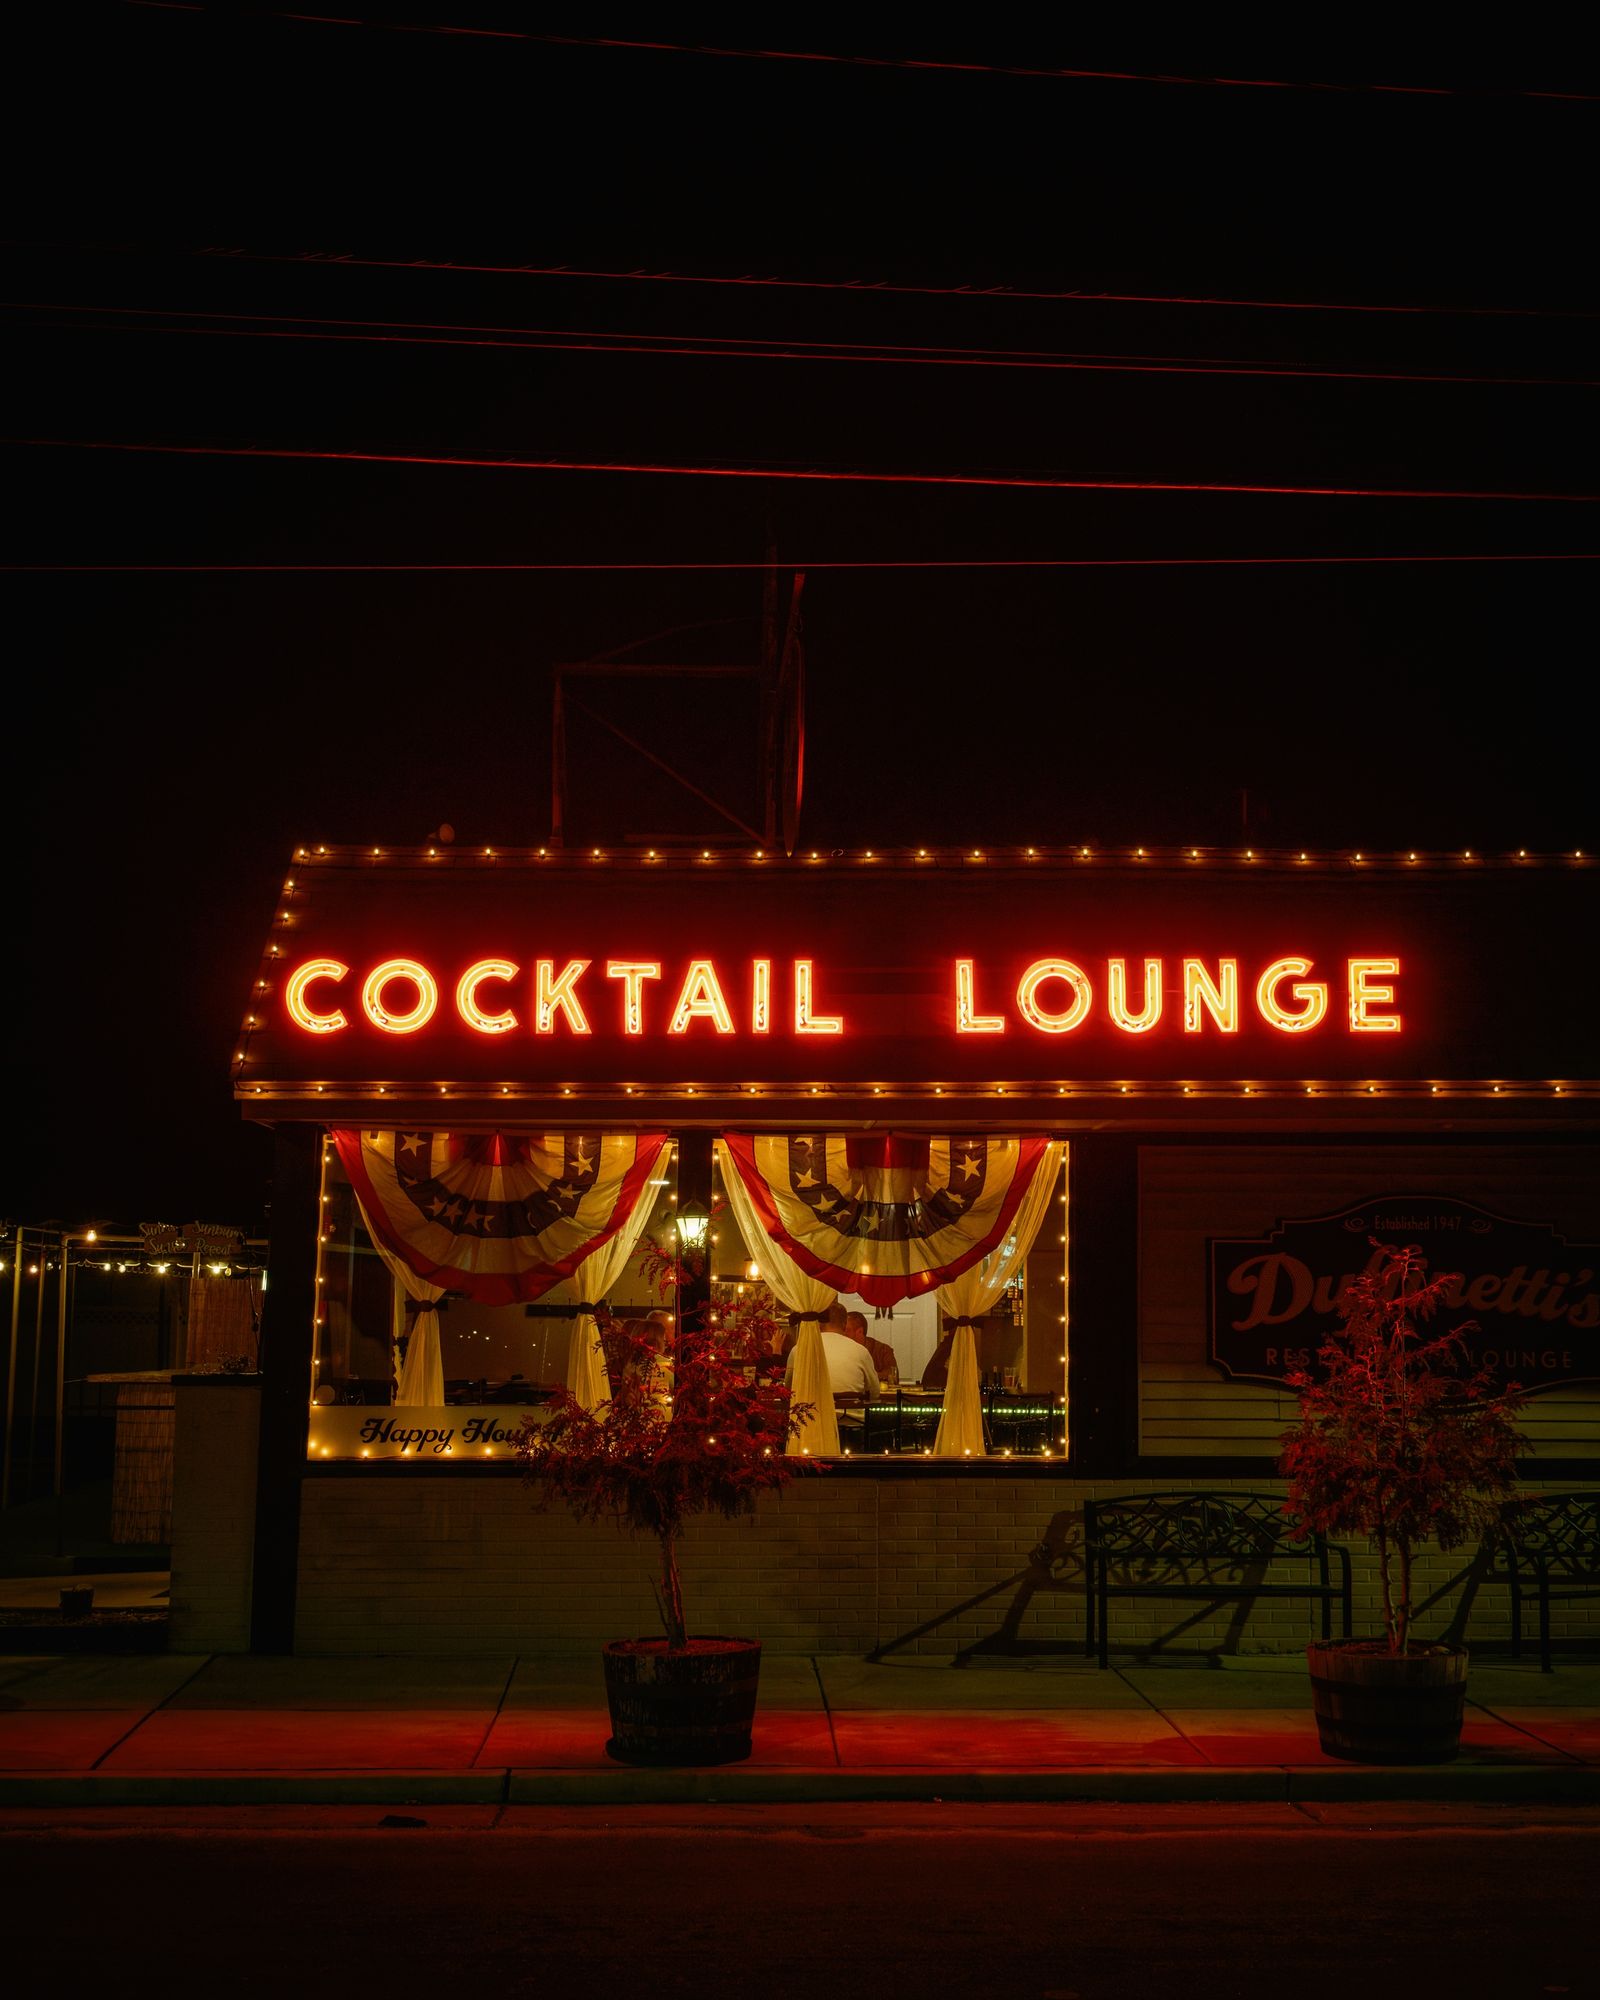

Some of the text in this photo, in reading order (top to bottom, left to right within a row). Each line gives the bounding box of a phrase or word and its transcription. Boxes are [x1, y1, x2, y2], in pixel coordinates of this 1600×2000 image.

[285, 957, 1401, 1035] COCKTAIL LOUNGE
[1374, 1214, 1464, 1232] Established 1947
[1470, 1348, 1574, 1369] LOUNGE
[359, 1417, 455, 1453] Happy
[461, 1417, 541, 1444] Hou
